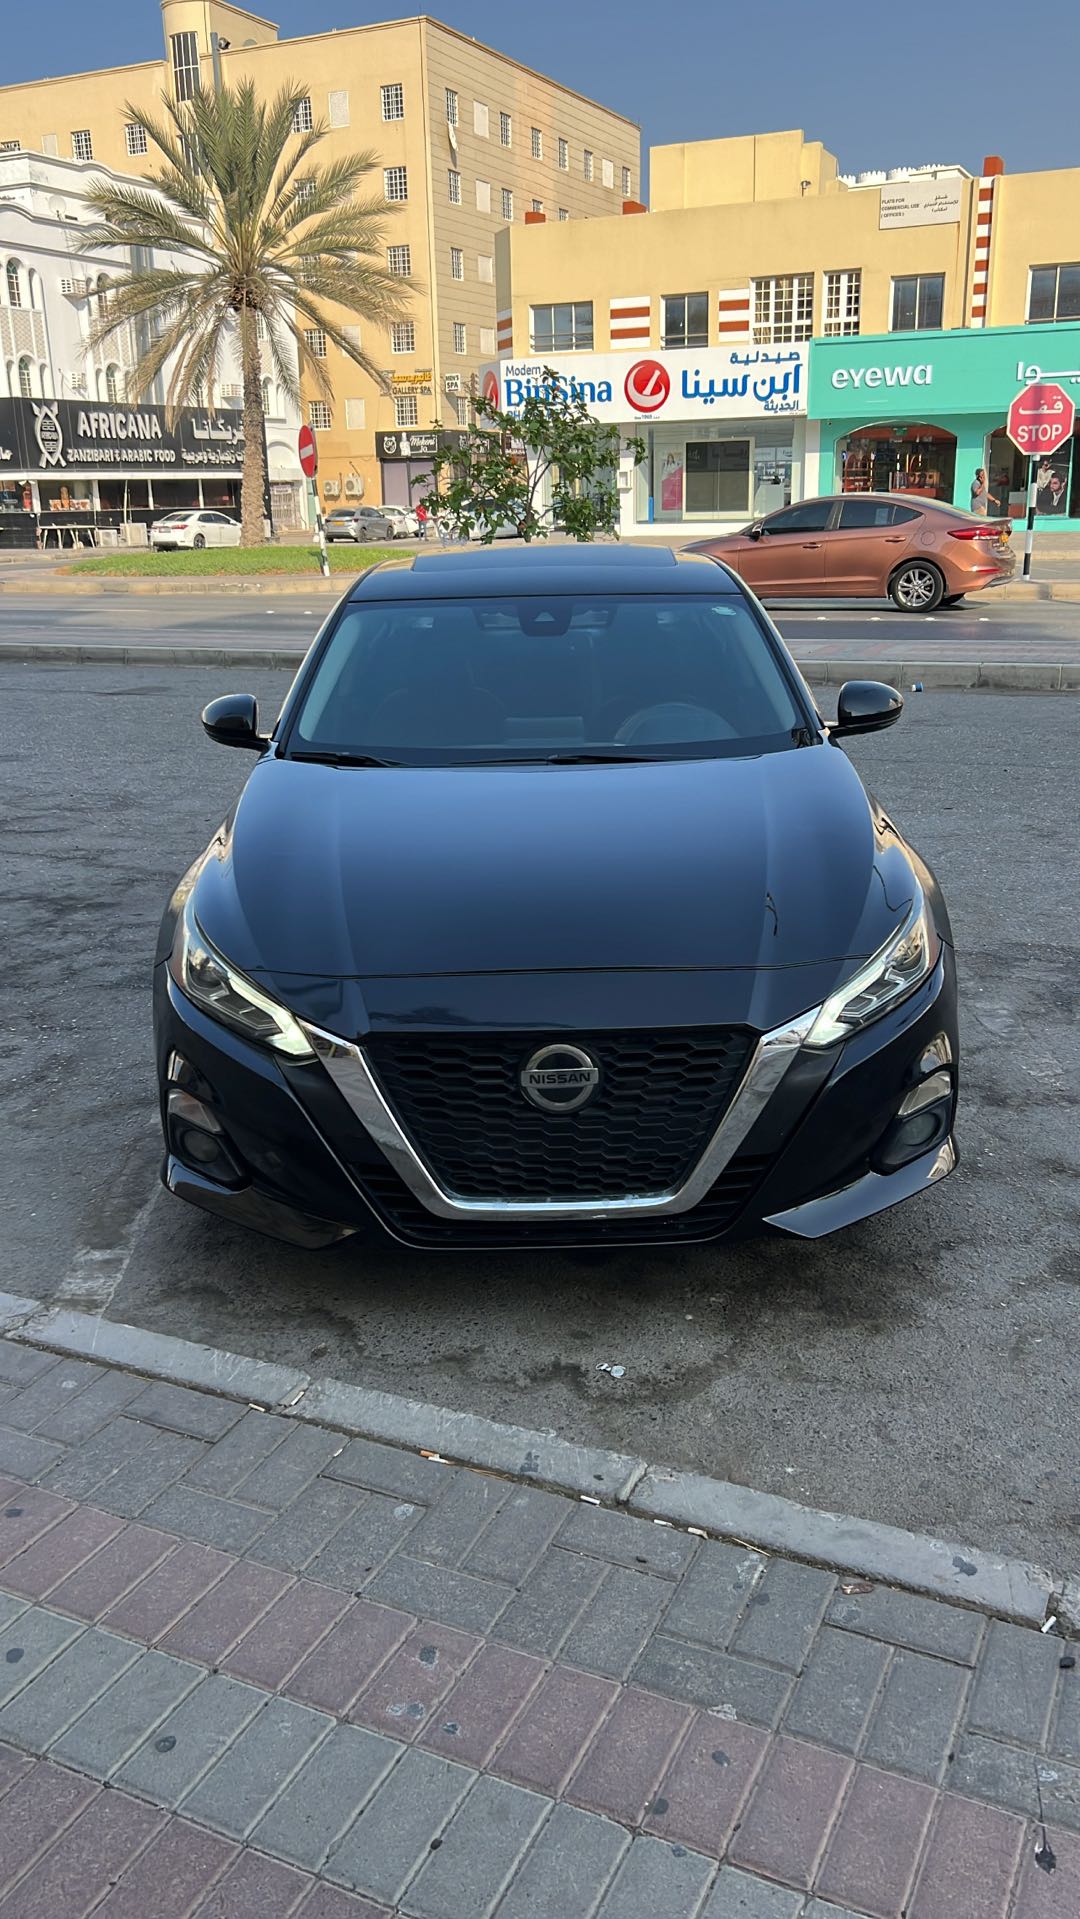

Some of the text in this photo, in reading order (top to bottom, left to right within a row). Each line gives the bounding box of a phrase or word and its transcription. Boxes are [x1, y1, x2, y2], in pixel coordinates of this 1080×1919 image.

[729, 350, 801, 366] صيدلية
[505, 363, 541, 377] Modern
[831, 364, 933, 389] eyewa
[392, 385, 432, 395] GALLERY SPA
[447, 381, 459, 389] SPA
[681, 363, 803, 405] ابن سينا
[763, 399, 799, 413] الحديثة
[1018, 395, 1064, 415] قف
[77, 411, 163, 440] AFRICANA
[1017, 424, 1063, 442] STOP
[66, 449, 114, 463] ZANZIBARI
[121, 449, 153, 463] ARABIC
[153, 449, 176, 463] FOOD
[529, 1072, 591, 1084] NISSAN
